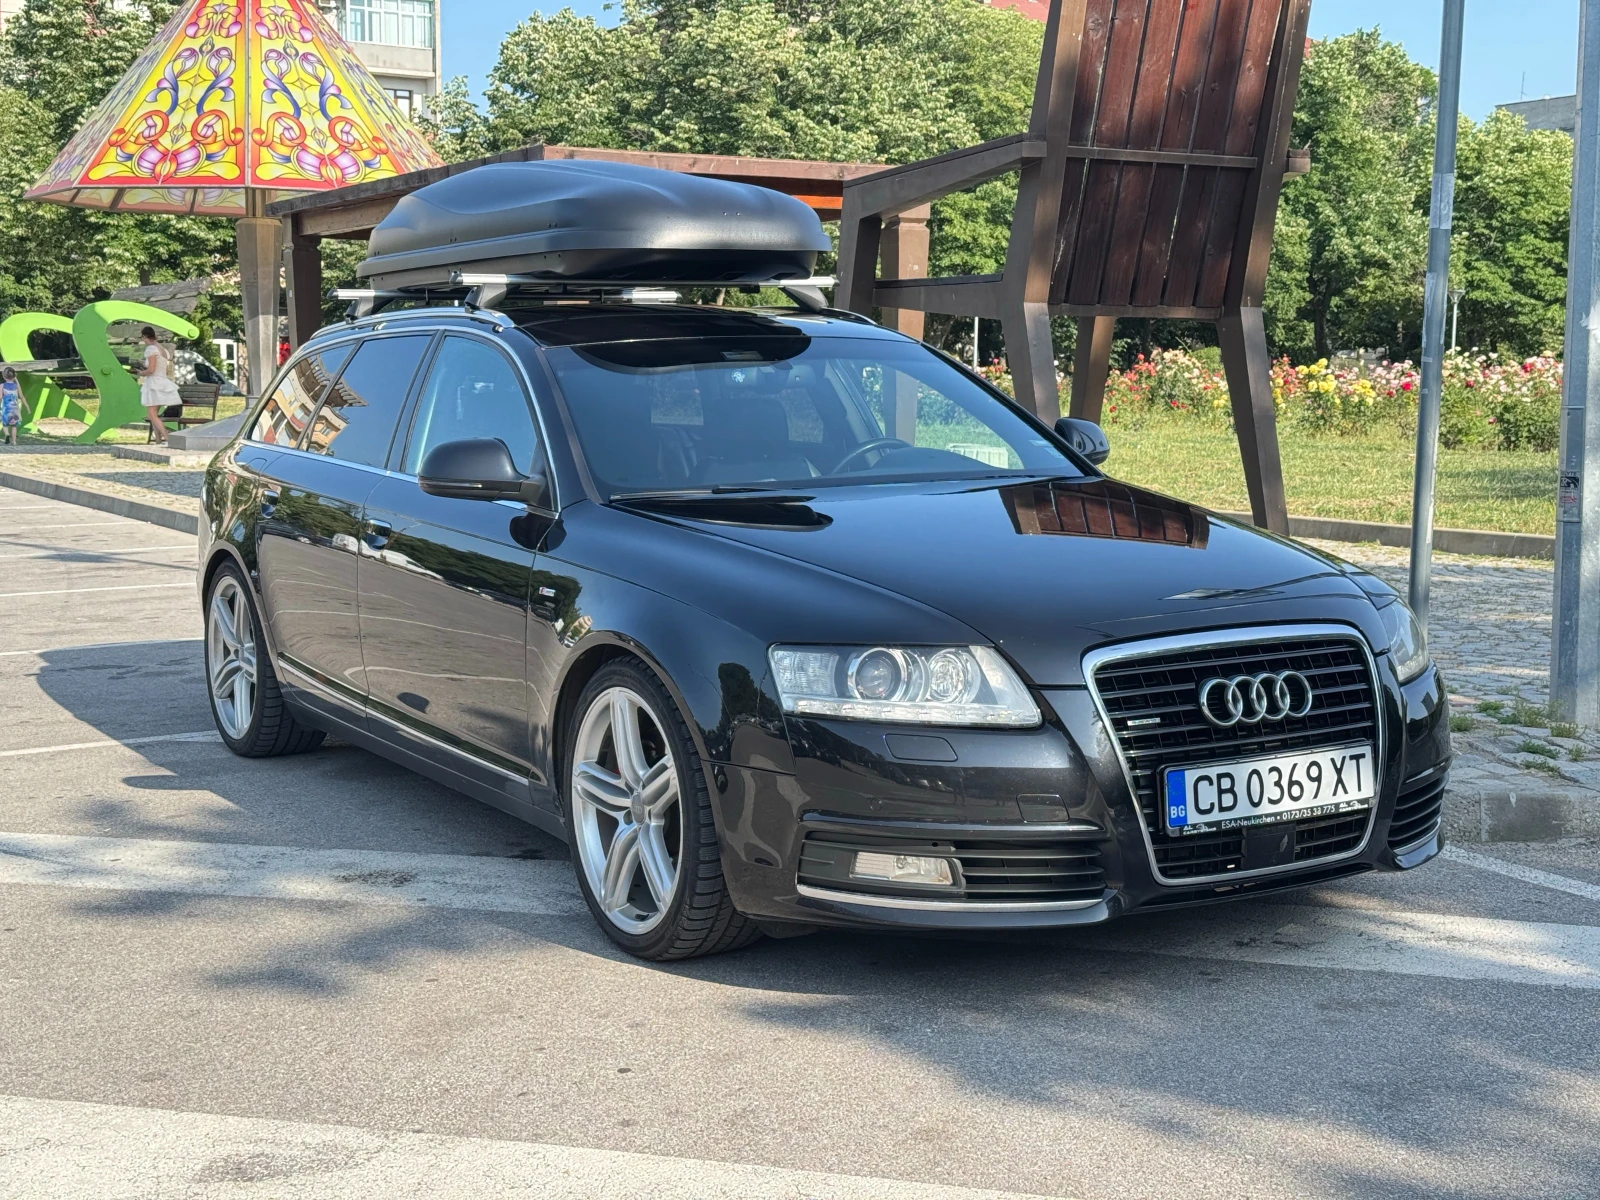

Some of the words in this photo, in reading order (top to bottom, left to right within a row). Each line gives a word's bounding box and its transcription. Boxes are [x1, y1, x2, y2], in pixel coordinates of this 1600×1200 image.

[1193, 772, 1238, 815] CB
[1246, 760, 1323, 808] 0369
[1330, 753, 1366, 797] XT
[1169, 805, 1186, 818] BG
[1221, 815, 1275, 829] ESA-Neukirchen
